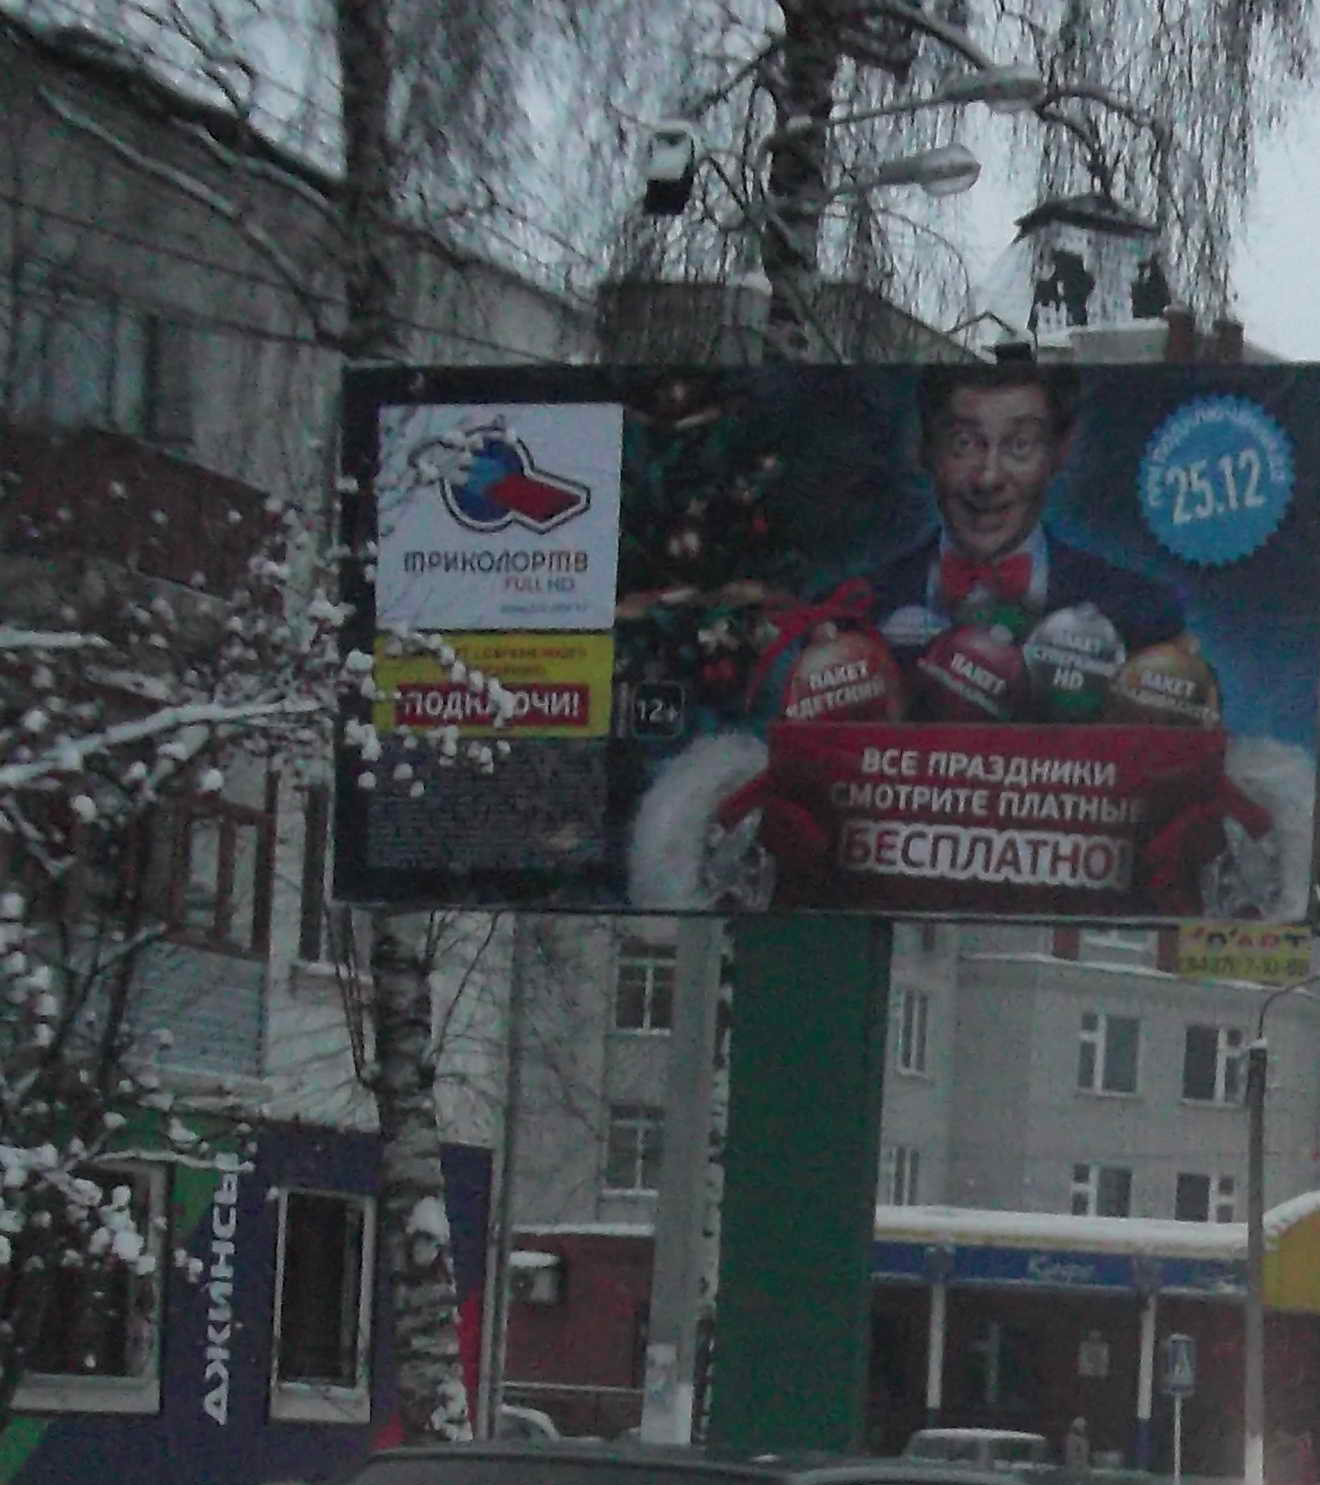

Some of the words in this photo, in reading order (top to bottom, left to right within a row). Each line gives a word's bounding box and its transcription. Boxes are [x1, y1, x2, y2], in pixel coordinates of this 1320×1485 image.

[1165, 448, 1267, 525] 25.12
[505, 576, 542, 592] FULL
[547, 577, 576, 593] HD
[809, 659, 868, 691] ПАКЕТ
[1053, 667, 1085, 690] HD
[861, 746, 919, 776] ВСЕ
[928, 750, 1117, 788] ПРАЗДНИКИ
[831, 781, 990, 817] СМОТРИТЕ
[998, 790, 1145, 824] ПЛАТНЫЕ
[846, 824, 1133, 884] БЕСПЛАТНО!
